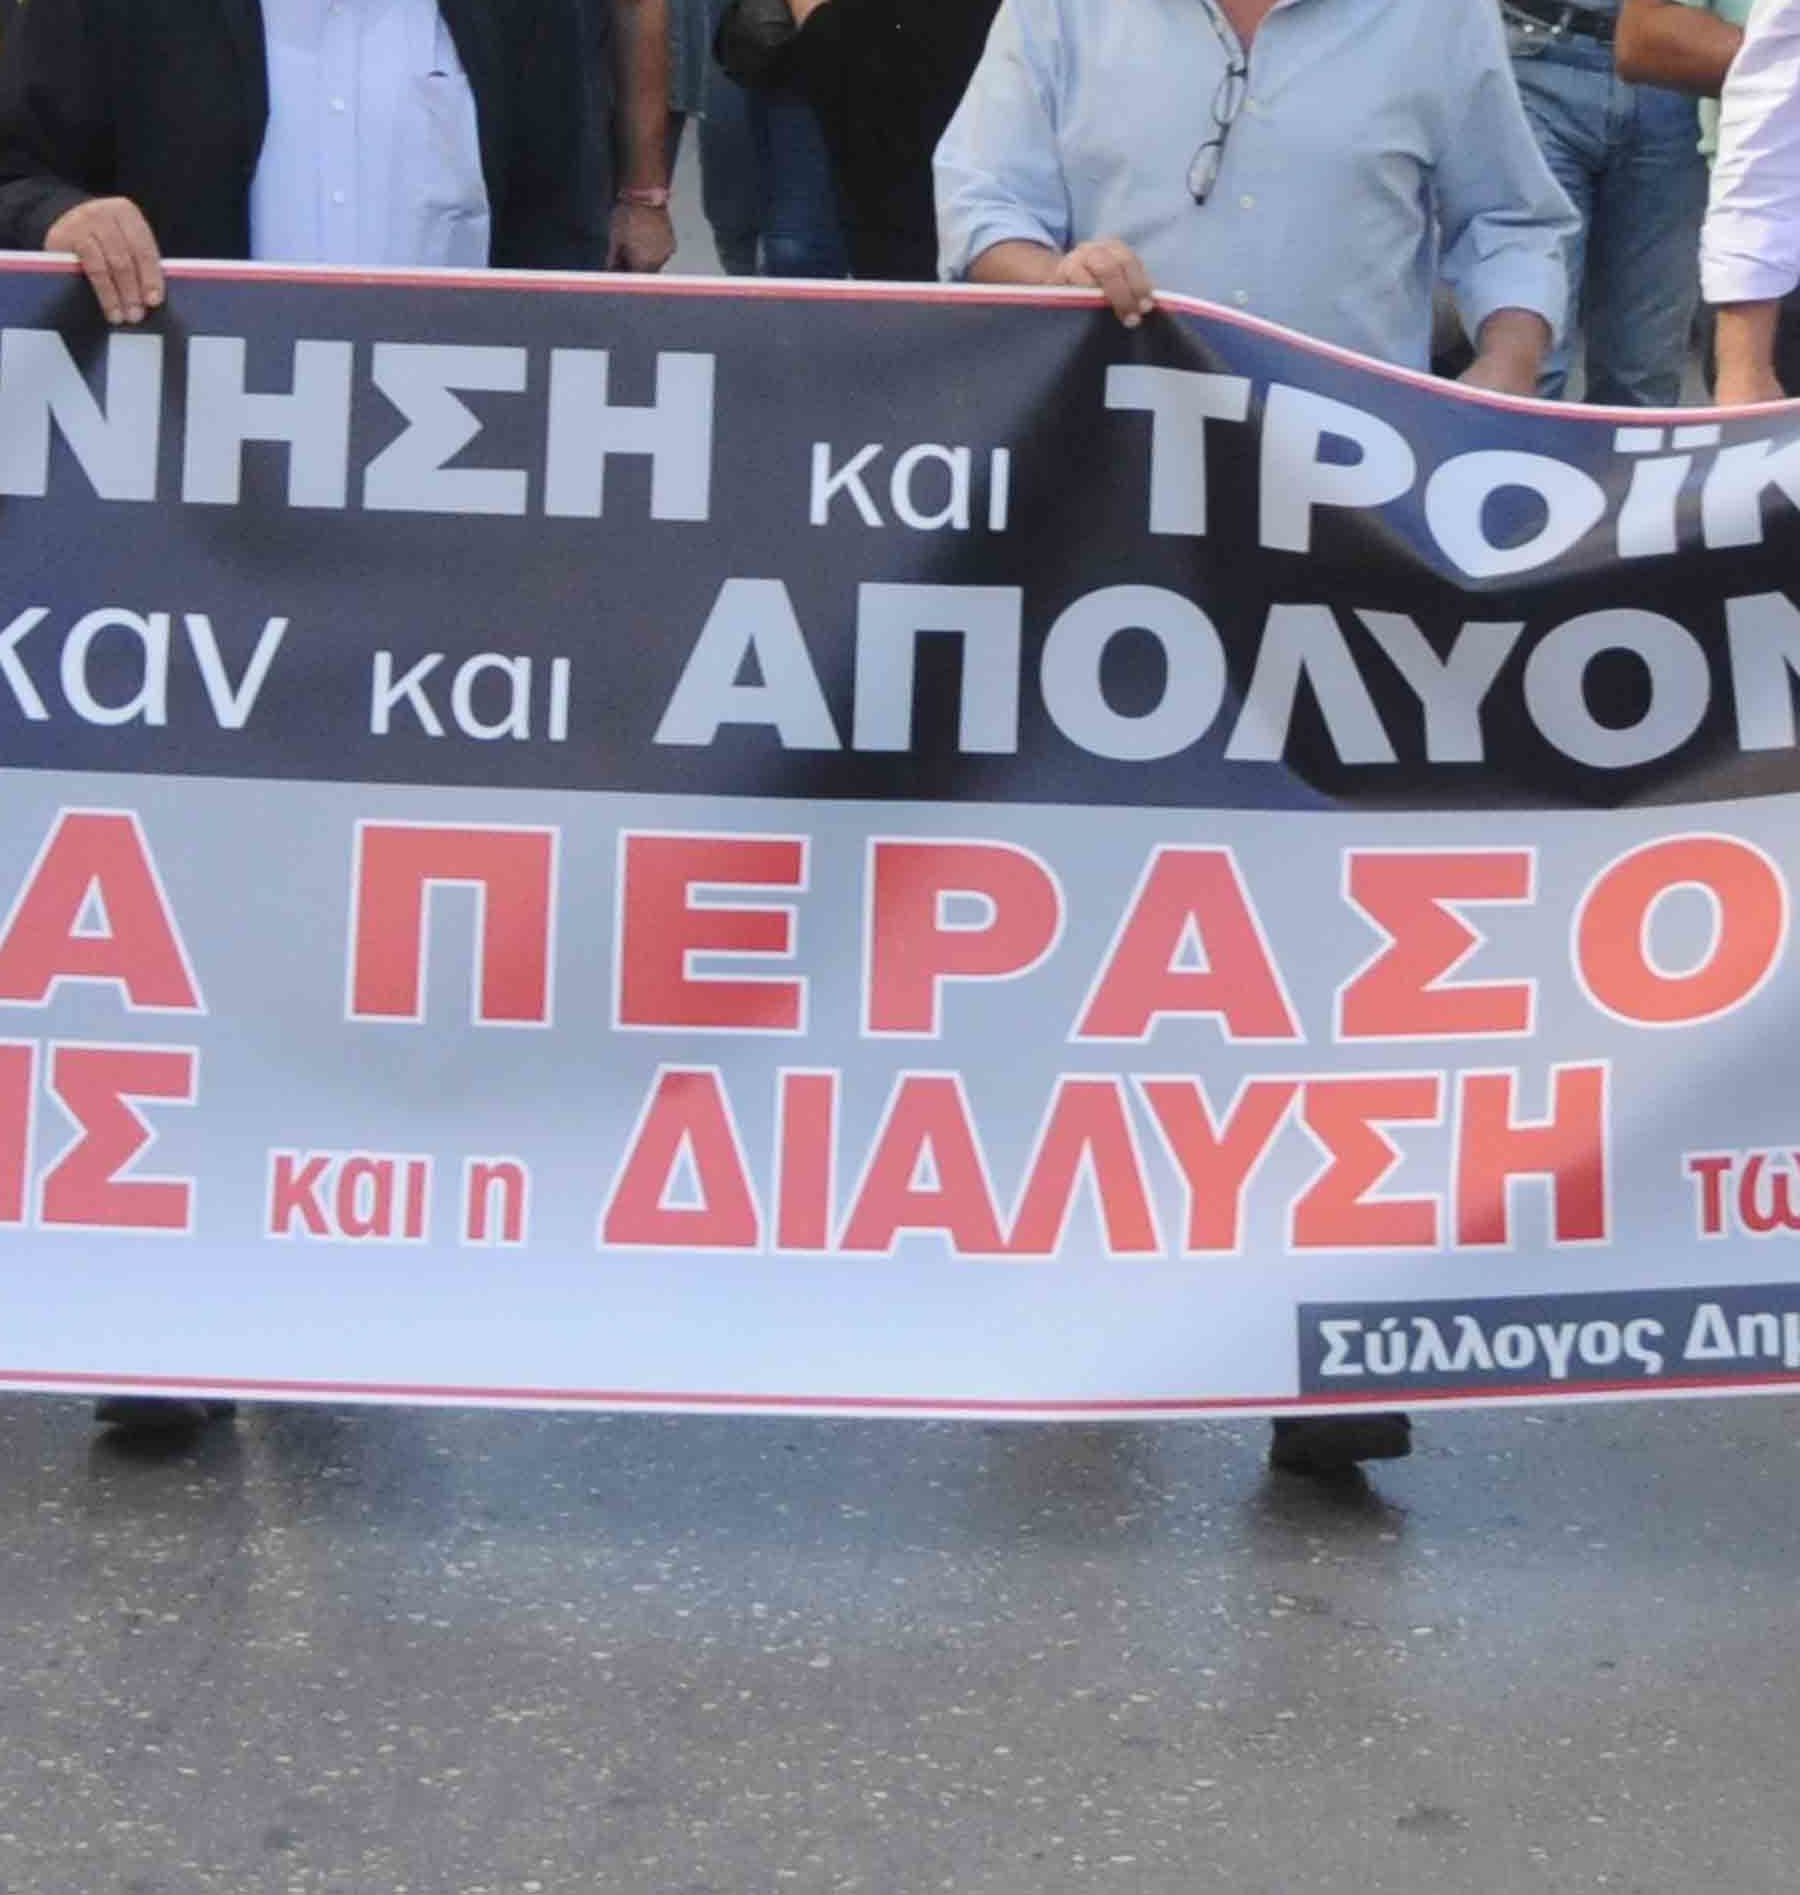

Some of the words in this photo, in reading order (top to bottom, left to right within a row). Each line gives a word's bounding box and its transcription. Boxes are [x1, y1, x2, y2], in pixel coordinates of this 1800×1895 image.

[811, 441, 1008, 531] και
[370, 647, 570, 742] και
[264, 1149, 425, 1242] και
[464, 1149, 525, 1247] η
[600, 1062, 1607, 1254] ΔΙΑΛΥΣΗ
[1318, 1316, 1662, 1380] Σύλλογος
